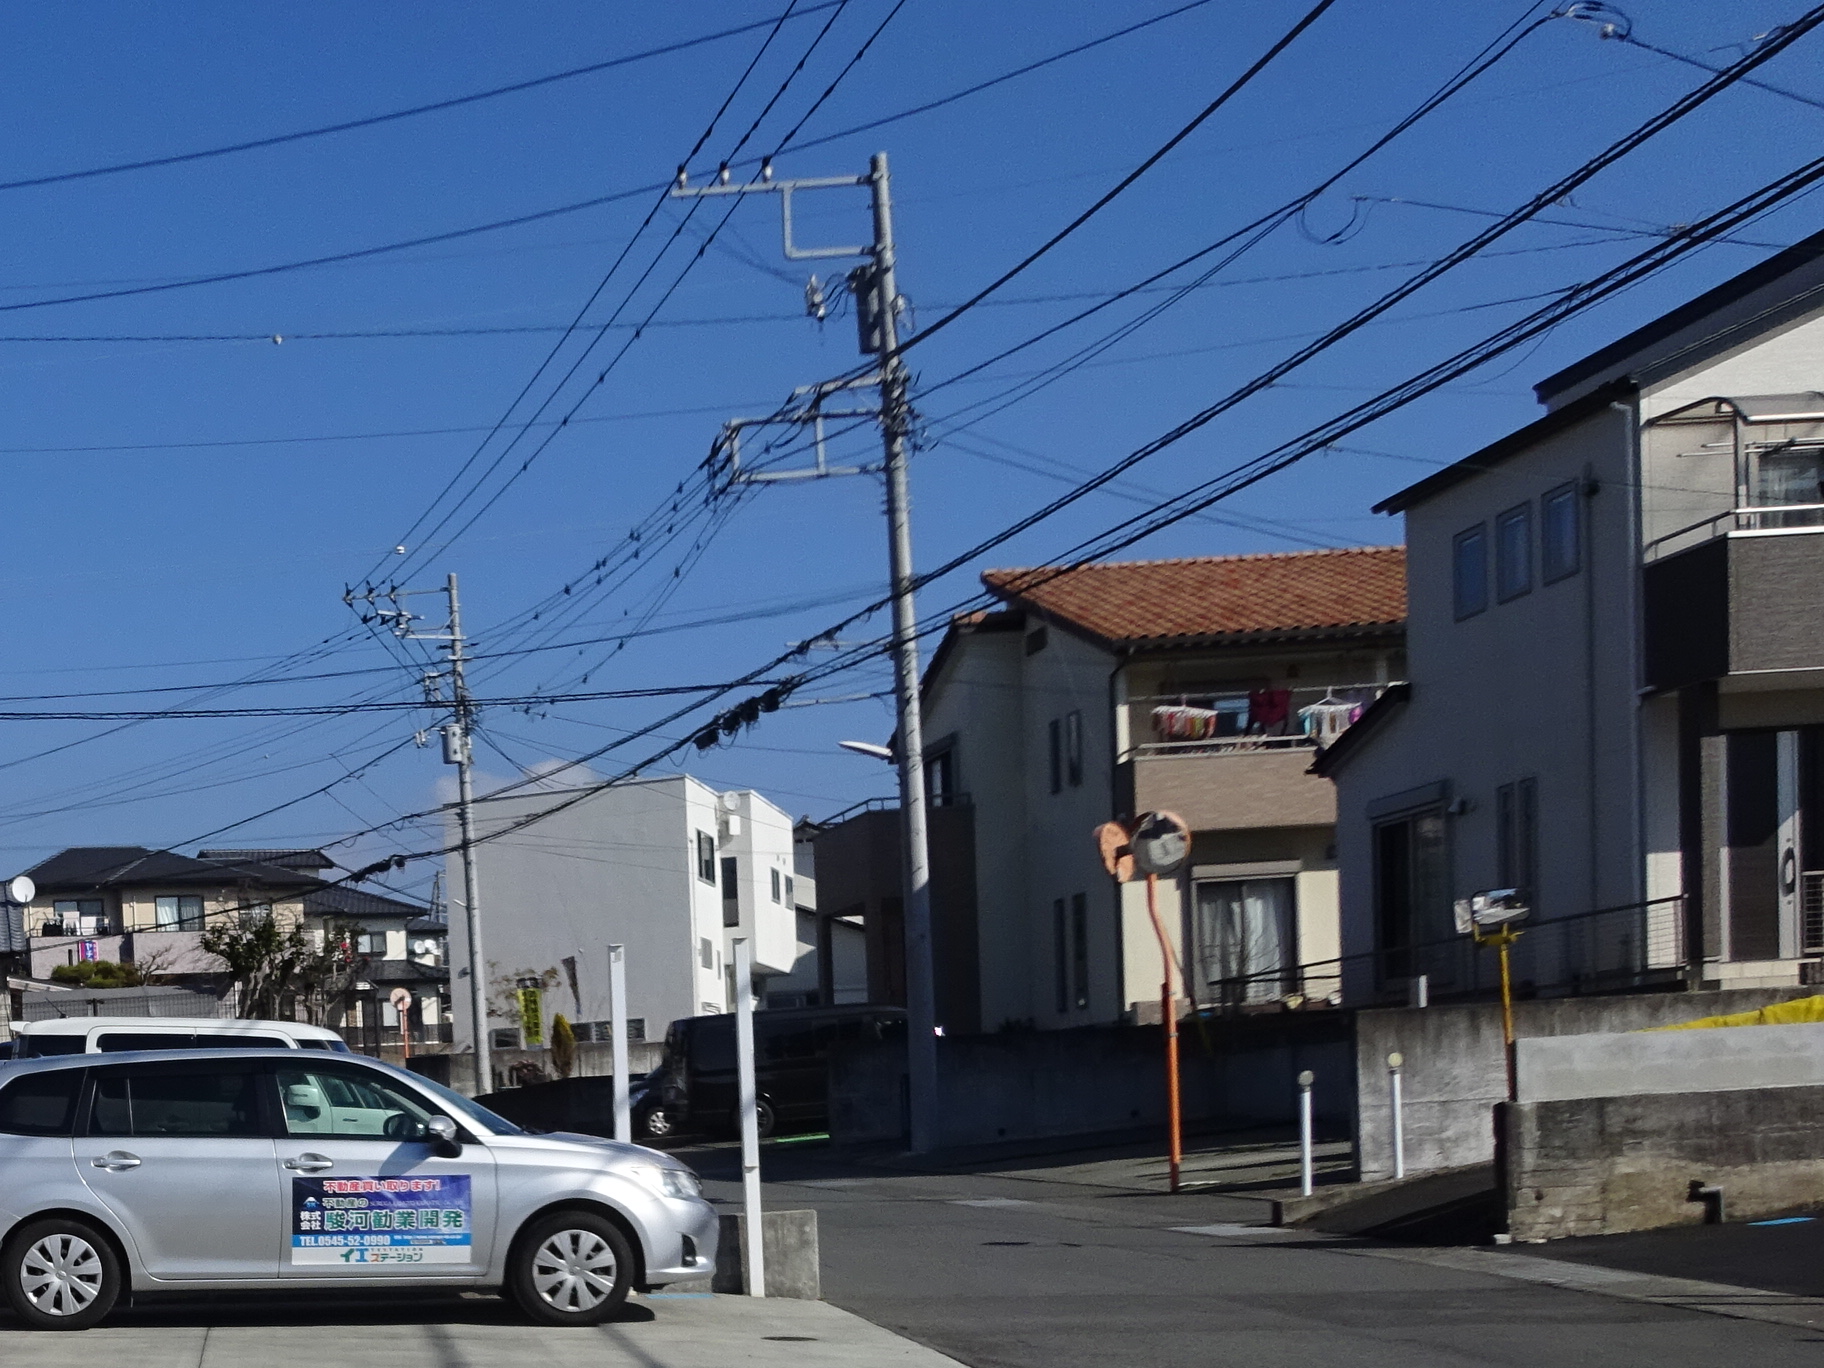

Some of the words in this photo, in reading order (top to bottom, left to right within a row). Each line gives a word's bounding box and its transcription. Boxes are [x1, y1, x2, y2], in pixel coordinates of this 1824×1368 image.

[324, 1209, 464, 1231] 駿河勧業開発
